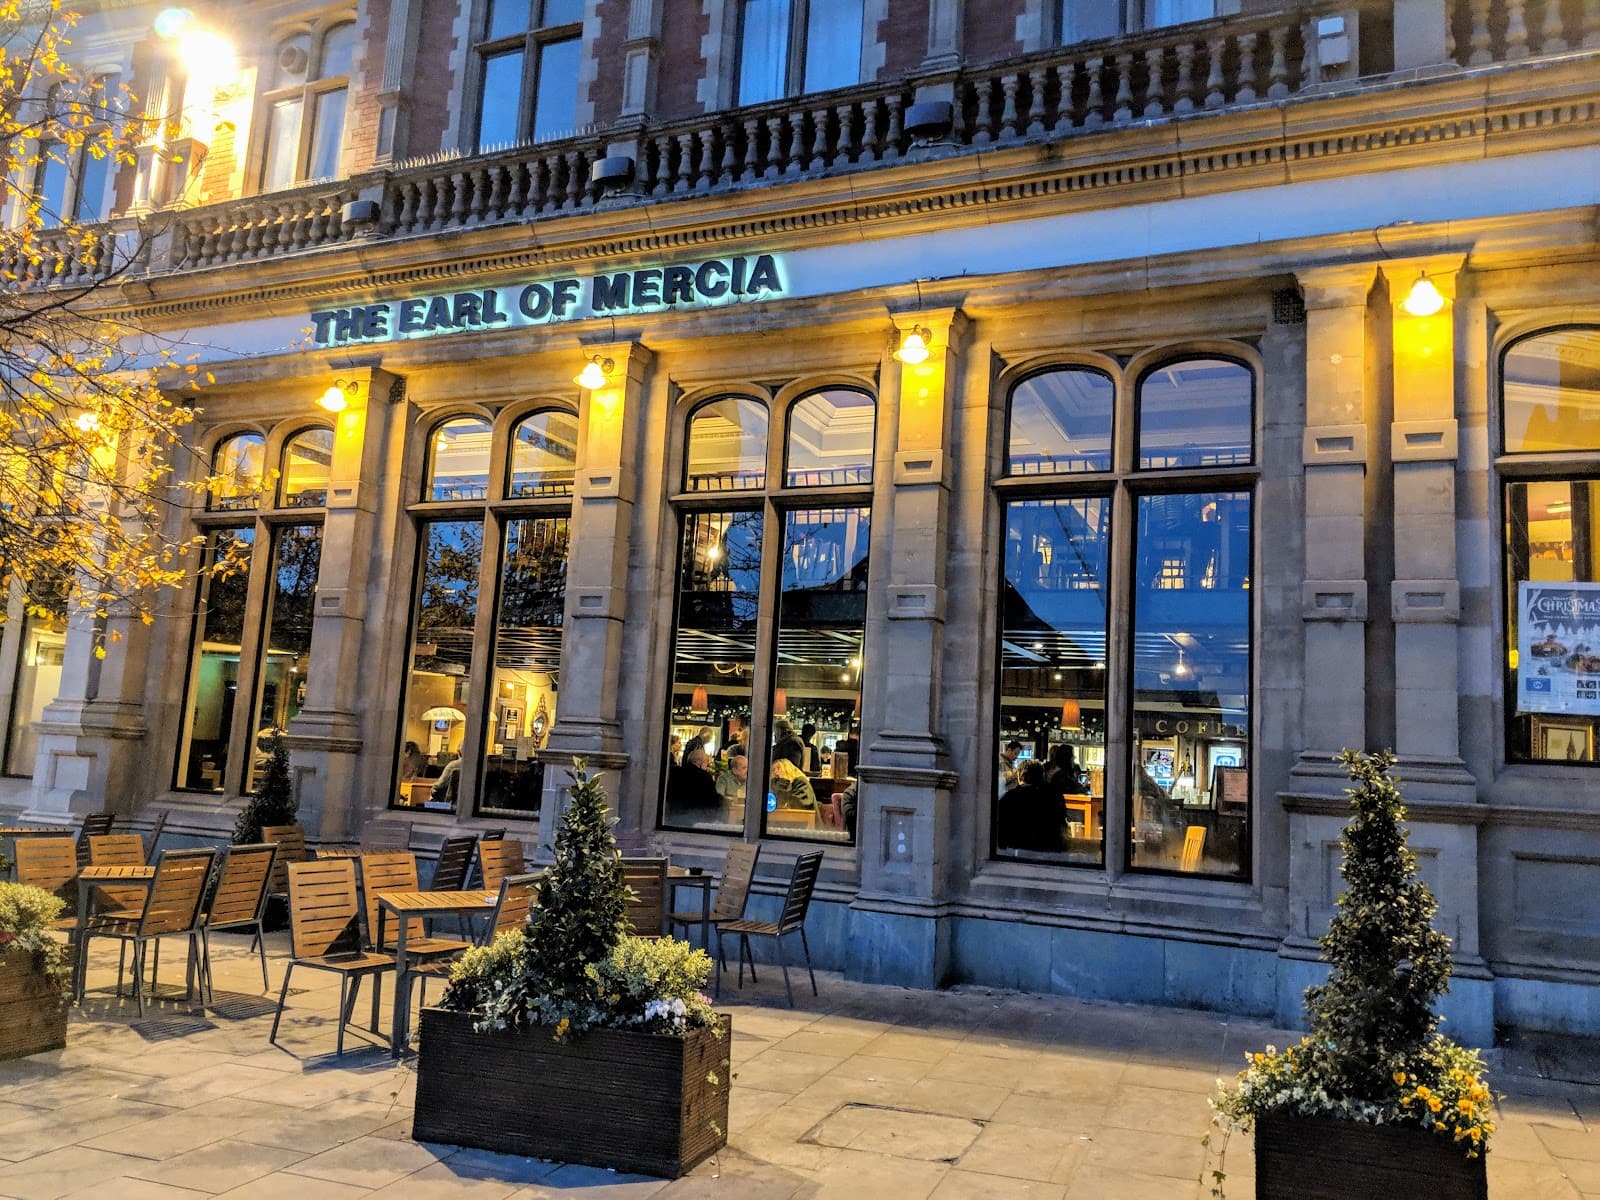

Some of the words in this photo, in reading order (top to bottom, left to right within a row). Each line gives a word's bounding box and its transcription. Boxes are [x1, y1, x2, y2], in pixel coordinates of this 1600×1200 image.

[311, 304, 390, 344] THE
[399, 290, 507, 334] EARL
[519, 279, 580, 319] OF
[592, 254, 783, 312] MERCIA
